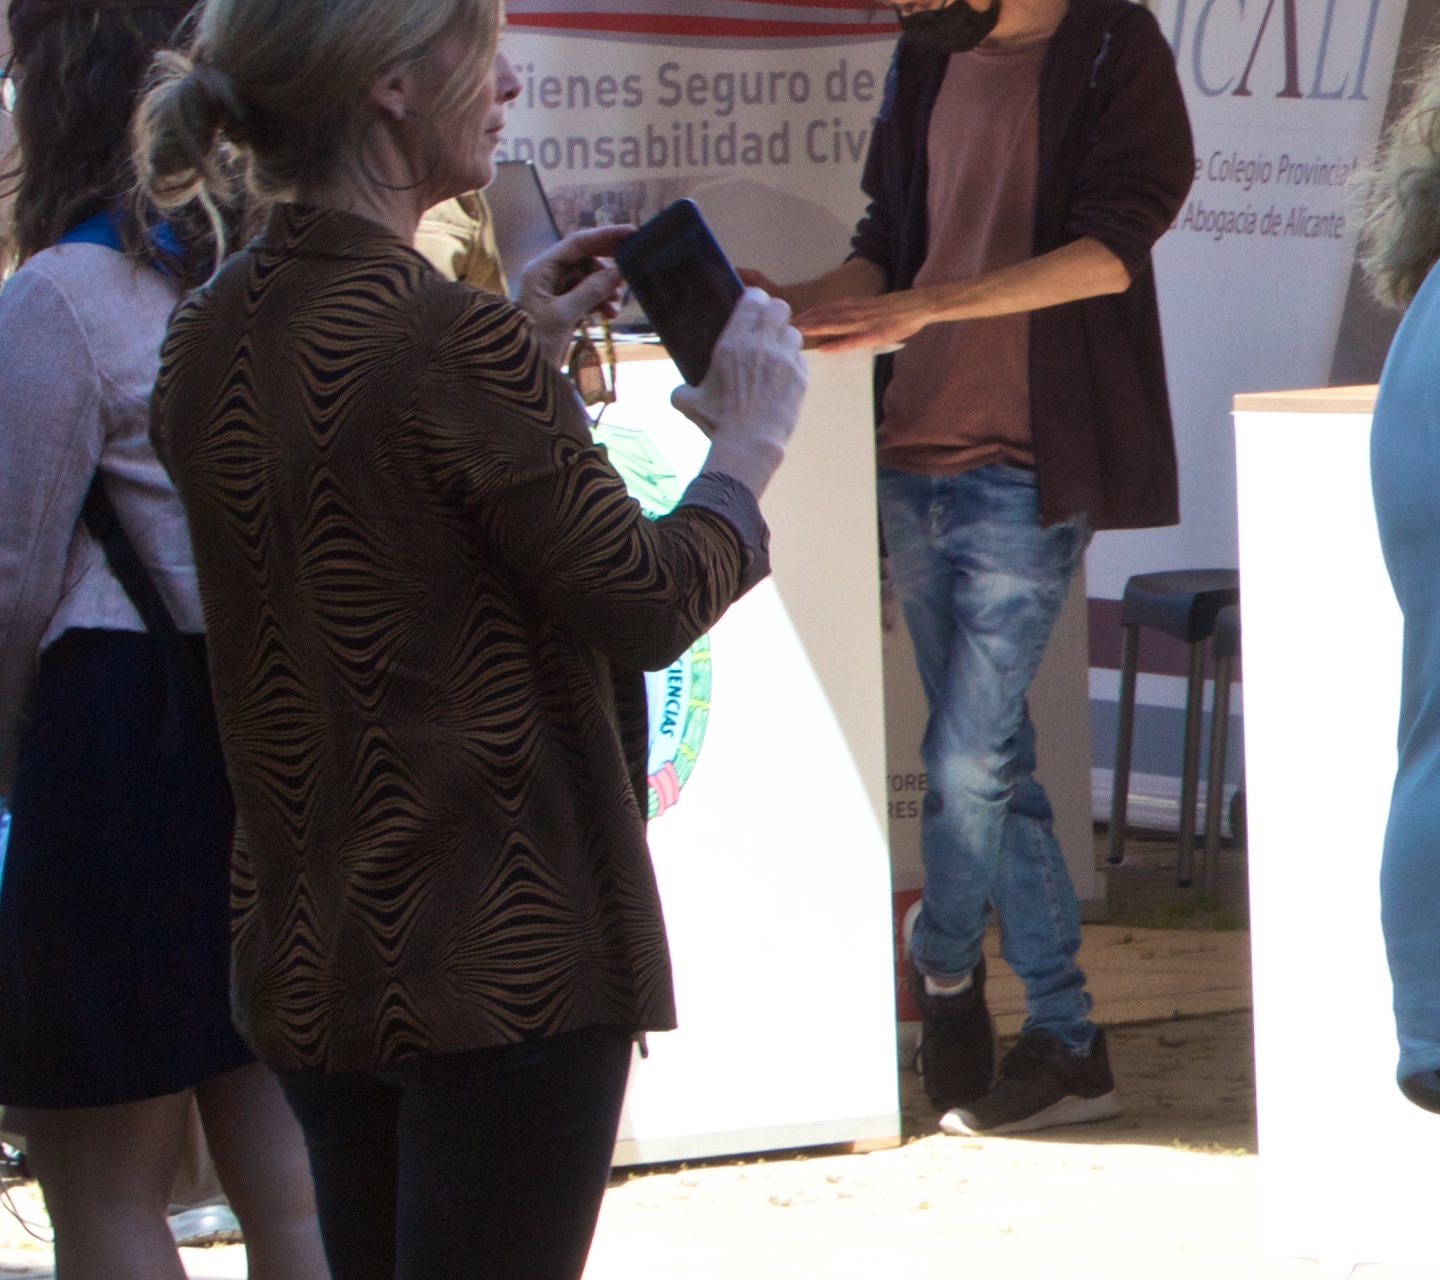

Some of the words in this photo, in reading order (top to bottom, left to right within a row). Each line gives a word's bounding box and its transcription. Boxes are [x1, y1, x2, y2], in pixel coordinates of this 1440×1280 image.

[657, 61, 810, 117] Seguro
[825, 58, 877, 104] de
[1208, 151, 1271, 191] Colegio
[1276, 154, 1358, 187] Provincial
[1260, 204, 1282, 236] de
[1283, 205, 1345, 238] Alicante
